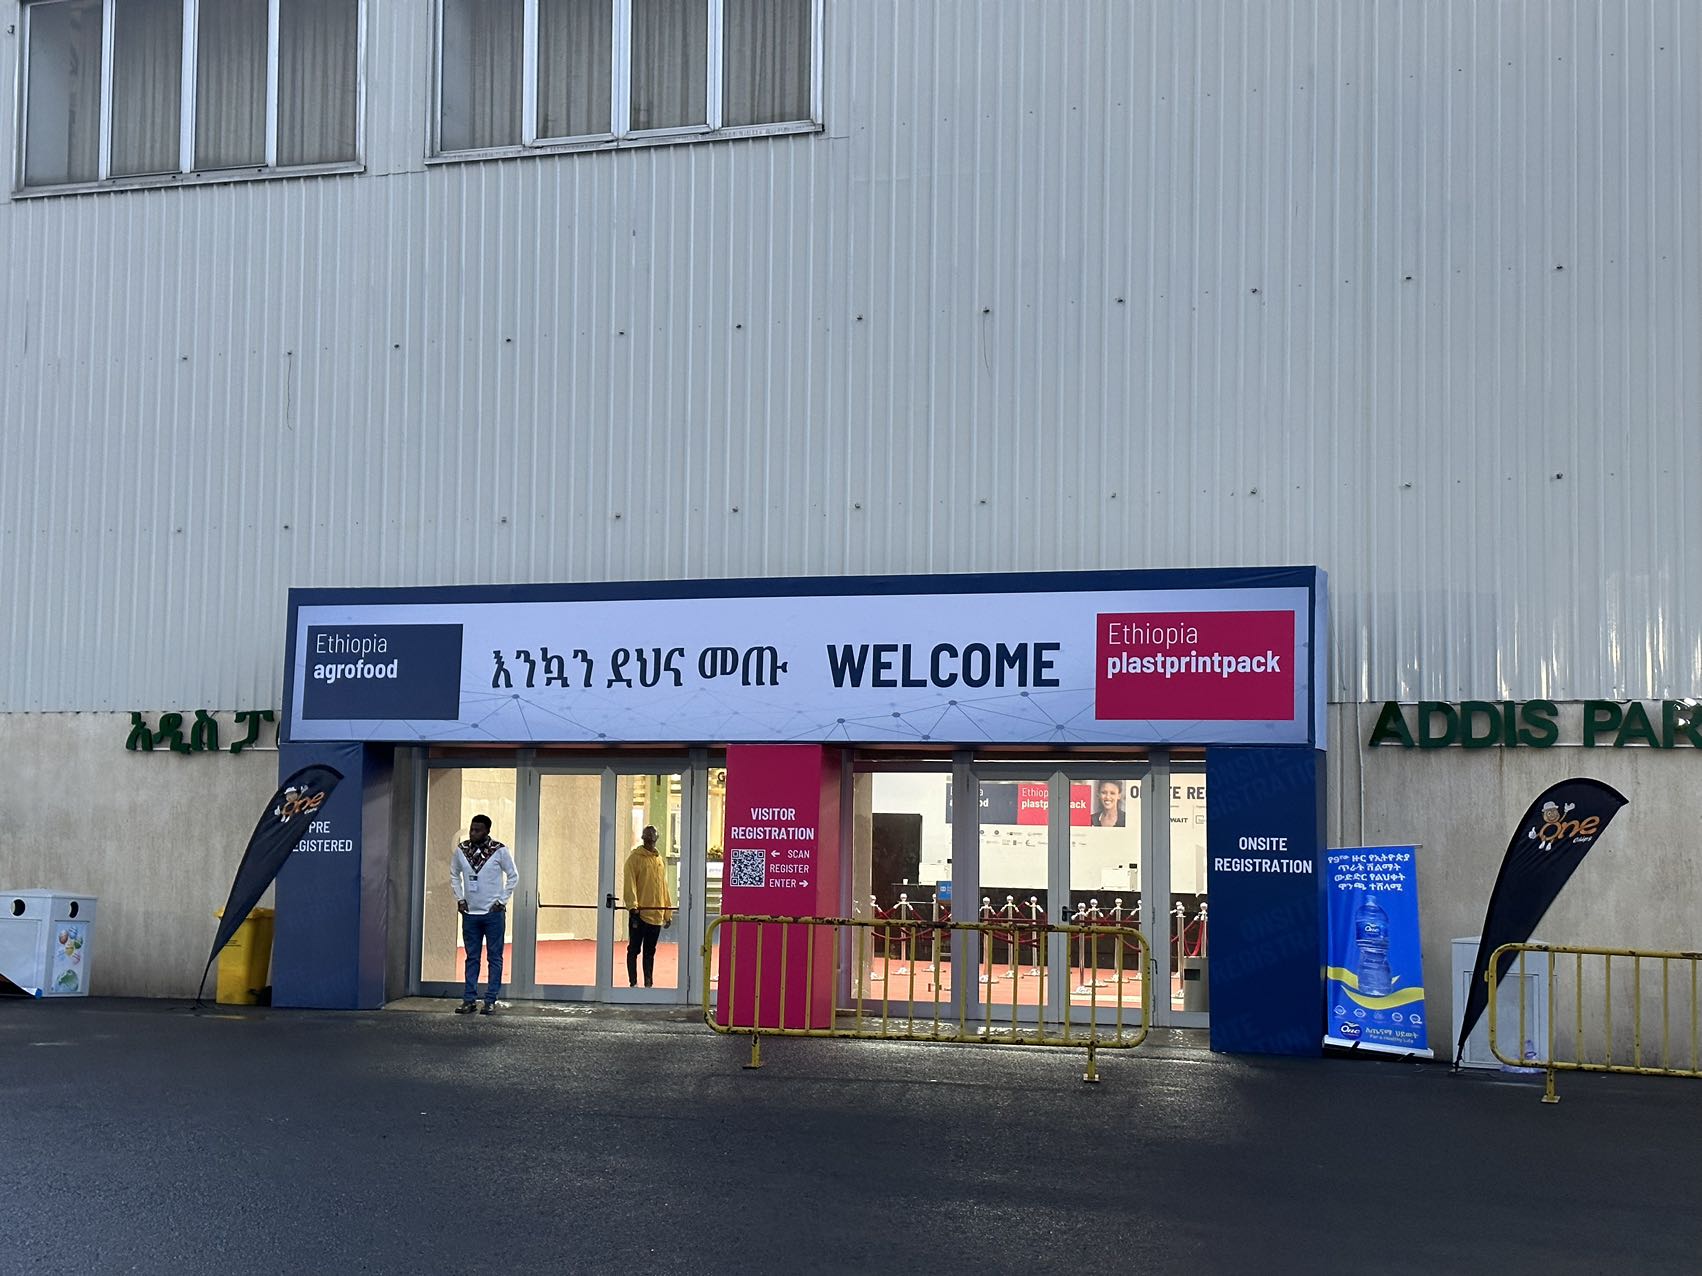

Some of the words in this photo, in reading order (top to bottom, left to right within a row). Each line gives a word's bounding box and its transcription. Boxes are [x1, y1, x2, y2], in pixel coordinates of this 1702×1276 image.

[316, 633, 387, 658] Ethiopia
[1109, 622, 1198, 649] Ethiopia
[313, 659, 398, 684] agrofood
[492, 647, 594, 688] እንኳን
[607, 648, 685, 688] ደህና
[697, 646, 788, 686] መጡ
[827, 642, 1061, 688] WELCOME
[1107, 650, 1281, 679] plastprintpack
[230, 710, 280, 754] ፓ
[1368, 700, 1559, 748] ADDIS
[1583, 700, 1702, 749] PAR
[751, 808, 796, 820] VISITOR
[309, 821, 331, 833] PRE
[731, 827, 815, 840] REGISTRATION
[1540, 816, 1600, 841] One
[293, 839, 353, 852] GISTERED
[787, 849, 810, 859] SCAN
[1239, 837, 1288, 851] ONSITE
[769, 864, 809, 873] REGISTER
[1214, 857, 1312, 873] REGISTRATION
[769, 879, 797, 888] ENTER
